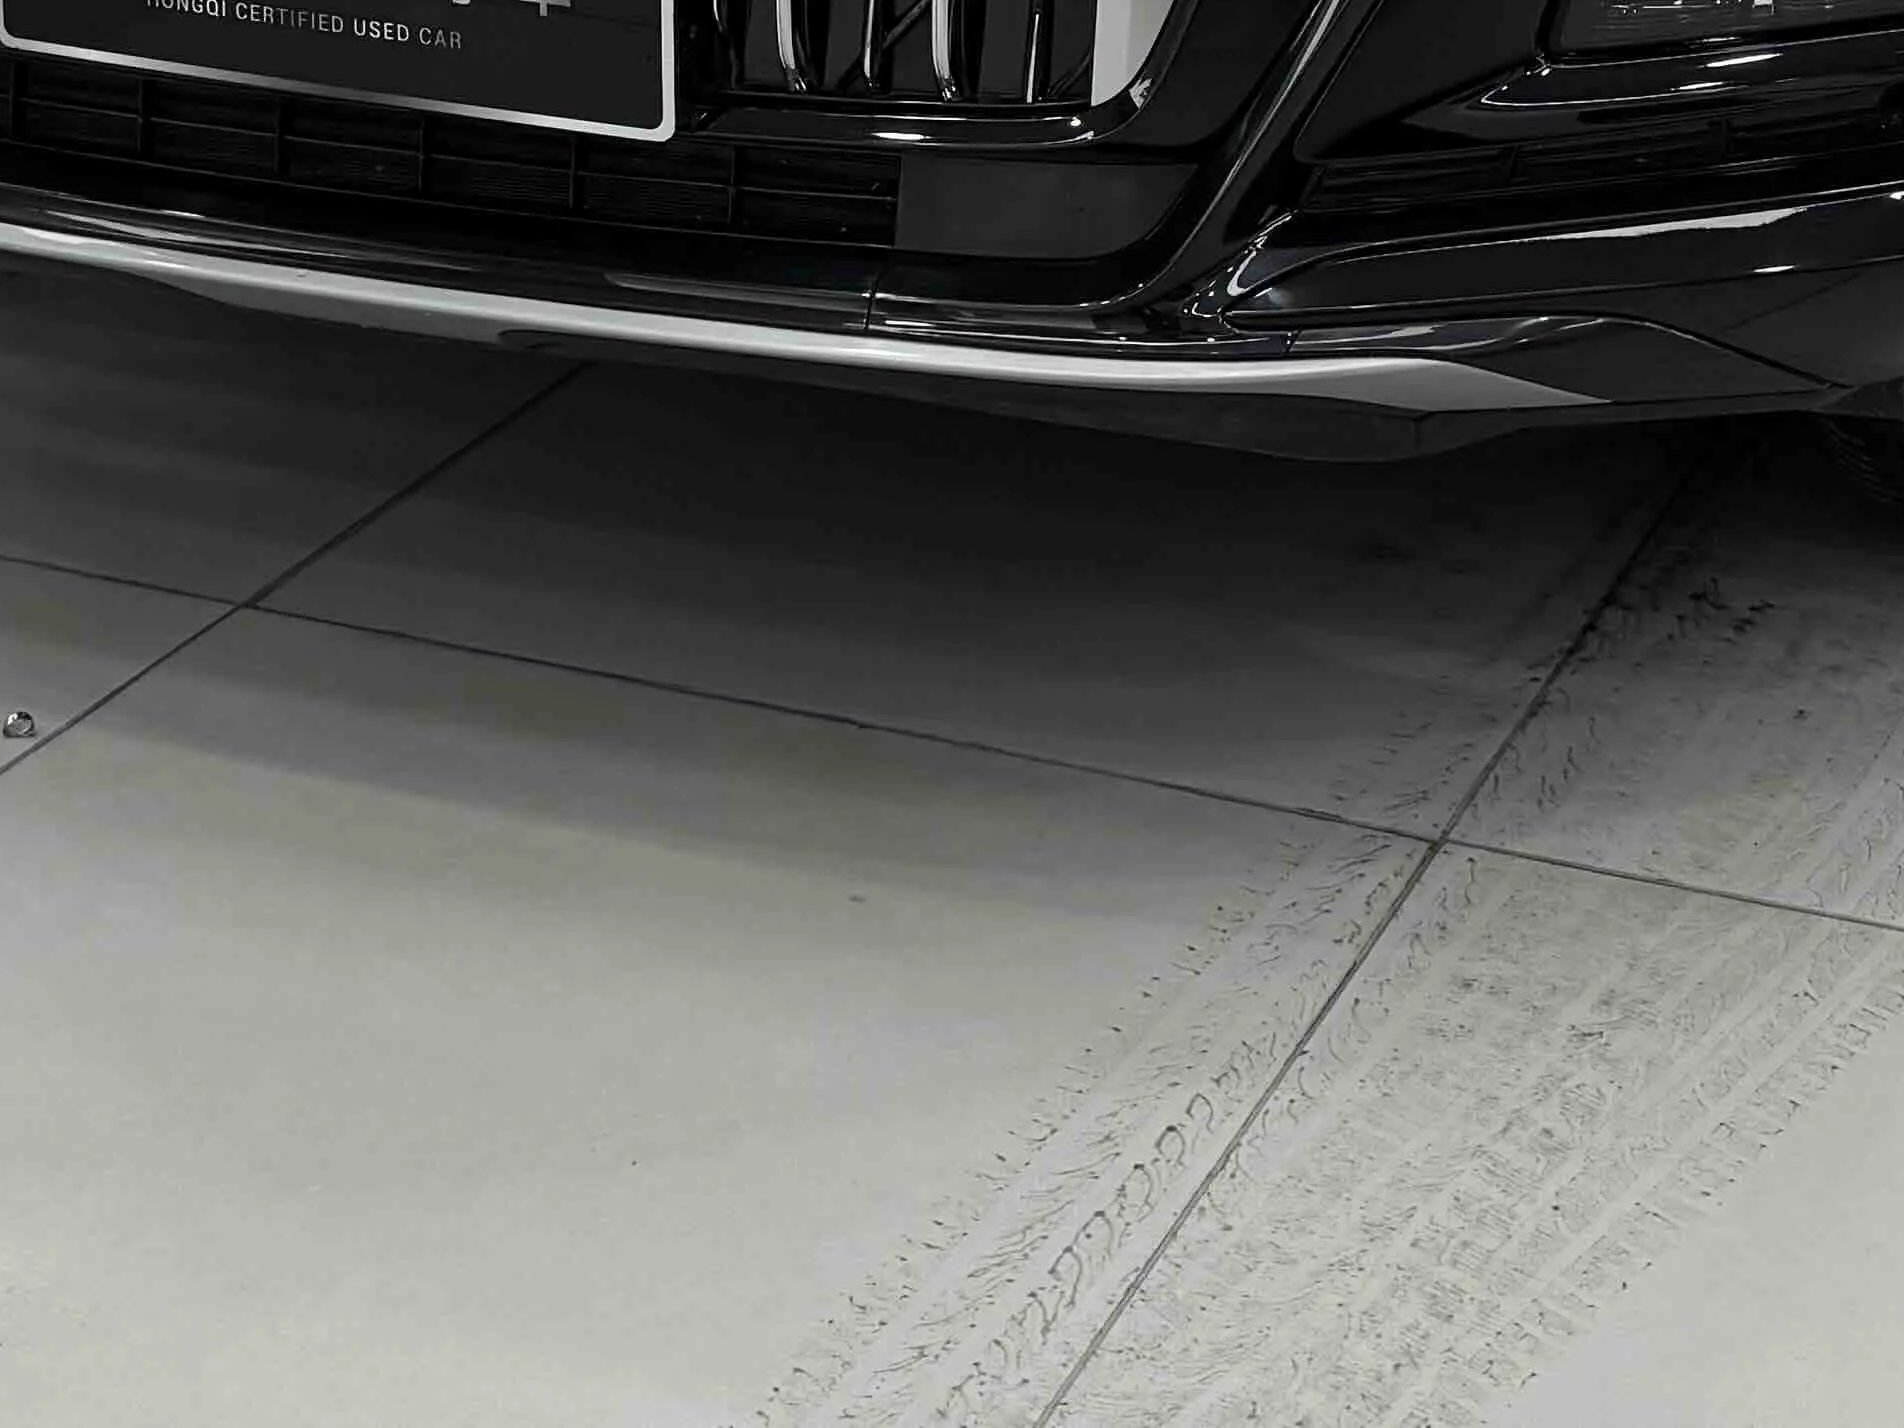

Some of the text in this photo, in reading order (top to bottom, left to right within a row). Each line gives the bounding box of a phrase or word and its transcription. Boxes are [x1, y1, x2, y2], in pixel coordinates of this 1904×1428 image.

[235, 2, 345, 34] CERTIFIED
[353, 20, 411, 43] USED
[419, 28, 463, 50] CAR
